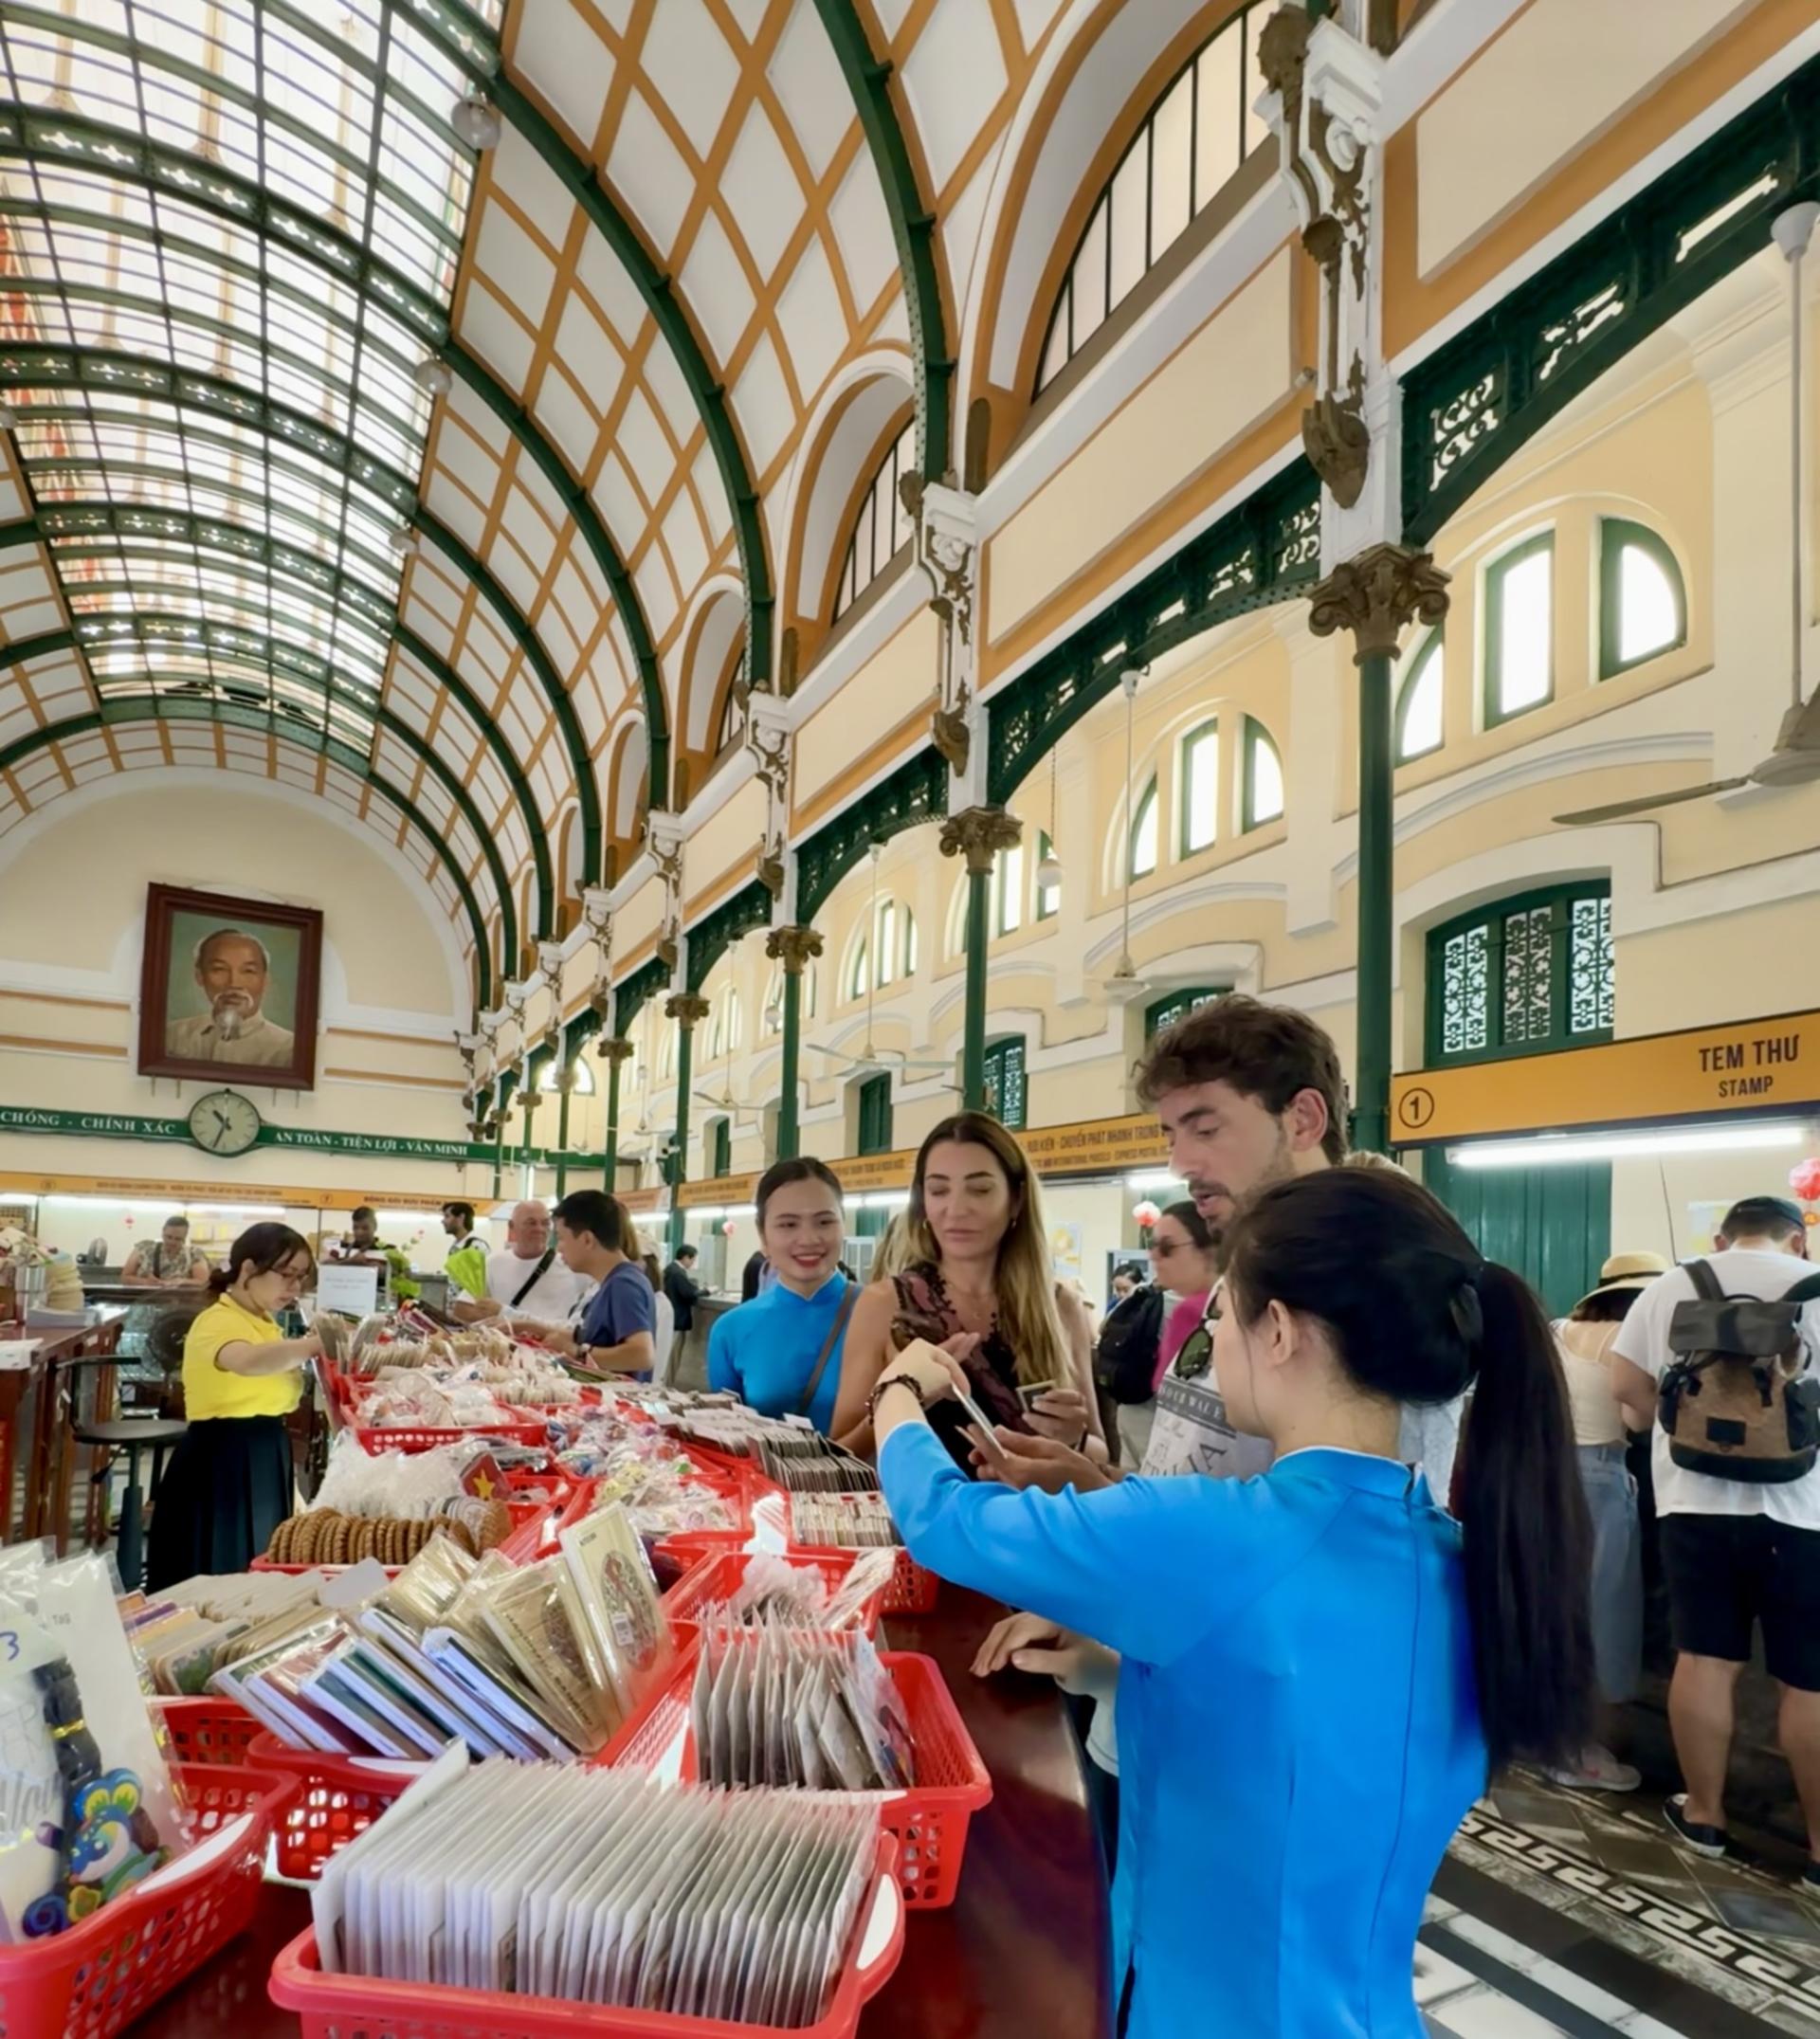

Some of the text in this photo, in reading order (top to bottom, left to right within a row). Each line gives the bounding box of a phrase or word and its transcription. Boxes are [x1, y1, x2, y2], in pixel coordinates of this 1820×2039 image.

[1699, 1034, 1800, 1072] TEM THƯ
[1718, 1076, 1774, 1098] STAMP
[1409, 1097, 1420, 1120] 1
[81, 1117, 136, 1131] CHÍNH
[142, 1120, 176, 1135] XÁC
[275, 1132, 293, 1142] AN
[295, 1131, 332, 1145] TOÀN
[341, 1136, 373, 1150] TIỆN
[374, 1138, 397, 1152] LỢI
[434, 1143, 468, 1156] MINH
